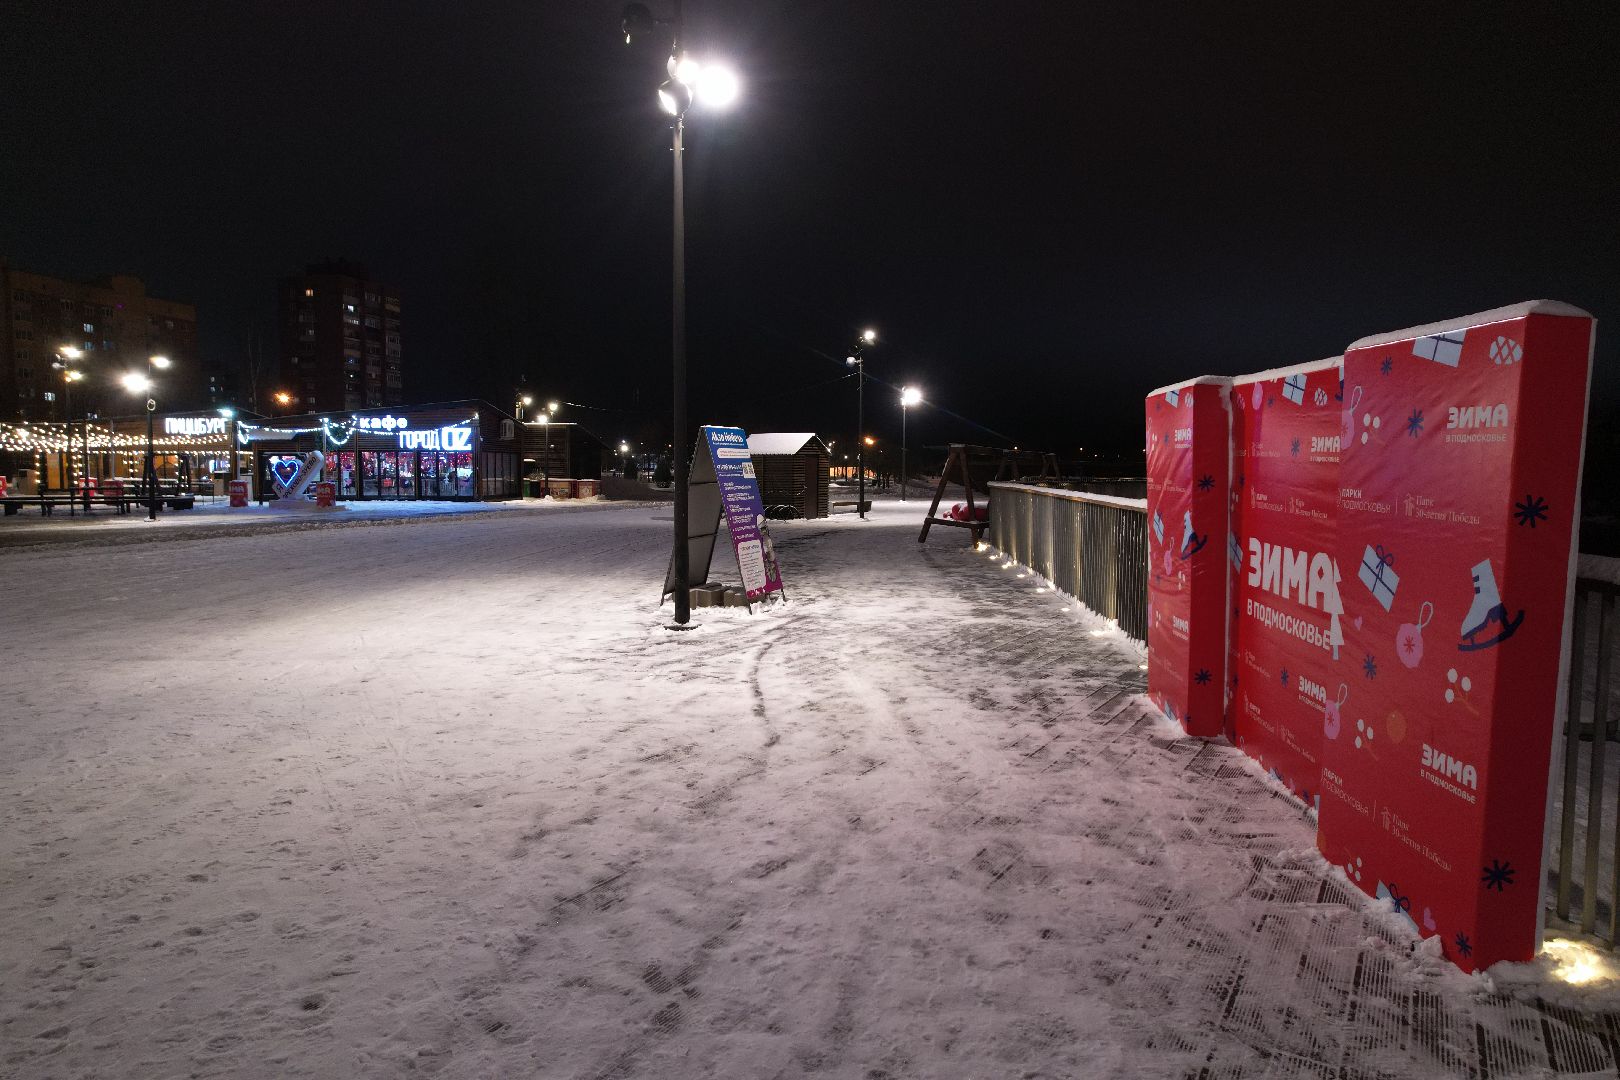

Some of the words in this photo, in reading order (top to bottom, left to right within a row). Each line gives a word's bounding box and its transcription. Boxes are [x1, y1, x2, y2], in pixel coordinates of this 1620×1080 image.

[165, 417, 228, 435] ПИЦЦБУРГ
[359, 414, 408, 431] кафе
[1447, 403, 1509, 429] ЗИМА
[400, 431, 441, 450] ГОРОД
[442, 427, 472, 450] OZ
[1174, 427, 1192, 442] ЗИМА
[1311, 435, 1341, 453] ЗИМА
[1452, 433, 1508, 444] ПОДМОСКОВЬЕ
[1248, 537, 1334, 614] ЗИМА
[1247, 598, 1253, 616] В
[1253, 601, 1331, 651] ПОДМОСКОВЬЕ
[1298, 675, 1327, 704] ЗИМА
[1421, 743, 1478, 790] ЗИМА
[1425, 771, 1477, 805] ПОДМОСКОВЬЕ
